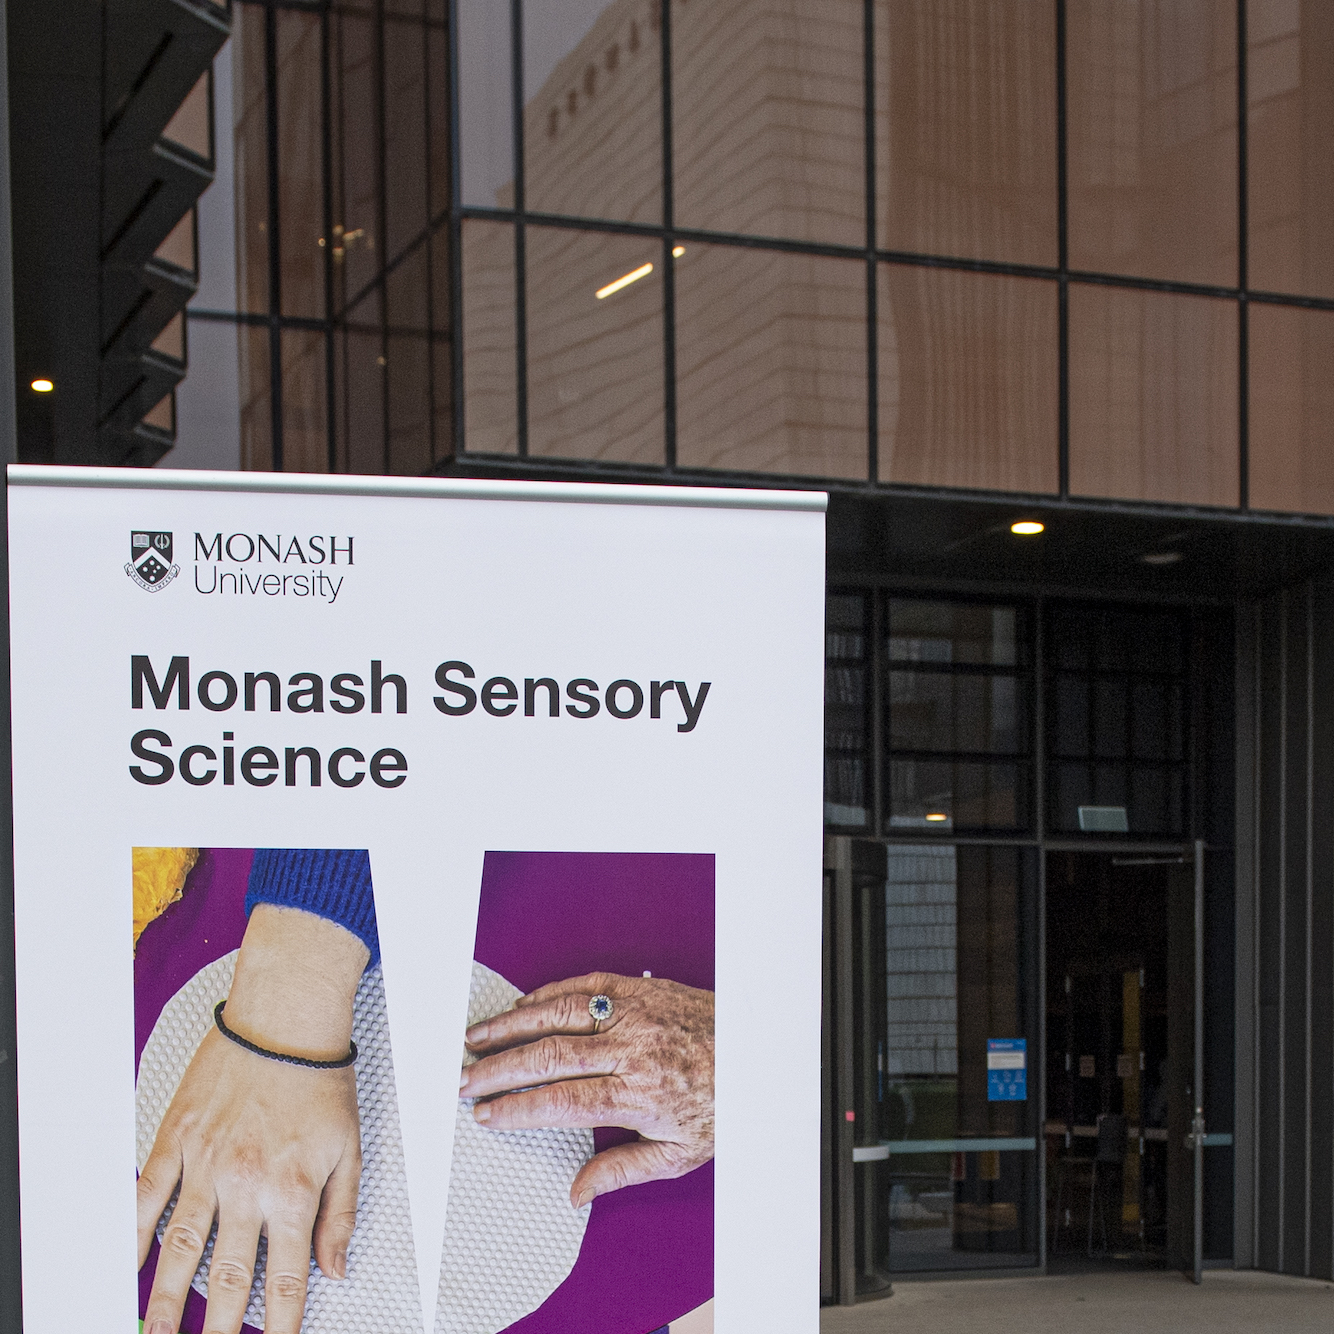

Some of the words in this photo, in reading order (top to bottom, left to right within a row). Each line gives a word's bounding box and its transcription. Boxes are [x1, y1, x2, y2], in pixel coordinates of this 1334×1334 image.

[194, 530, 354, 566] MONASH
[194, 563, 344, 604] University
[130, 654, 408, 715] Monash
[432, 660, 712, 733] Sensory
[128, 728, 409, 787] Science
